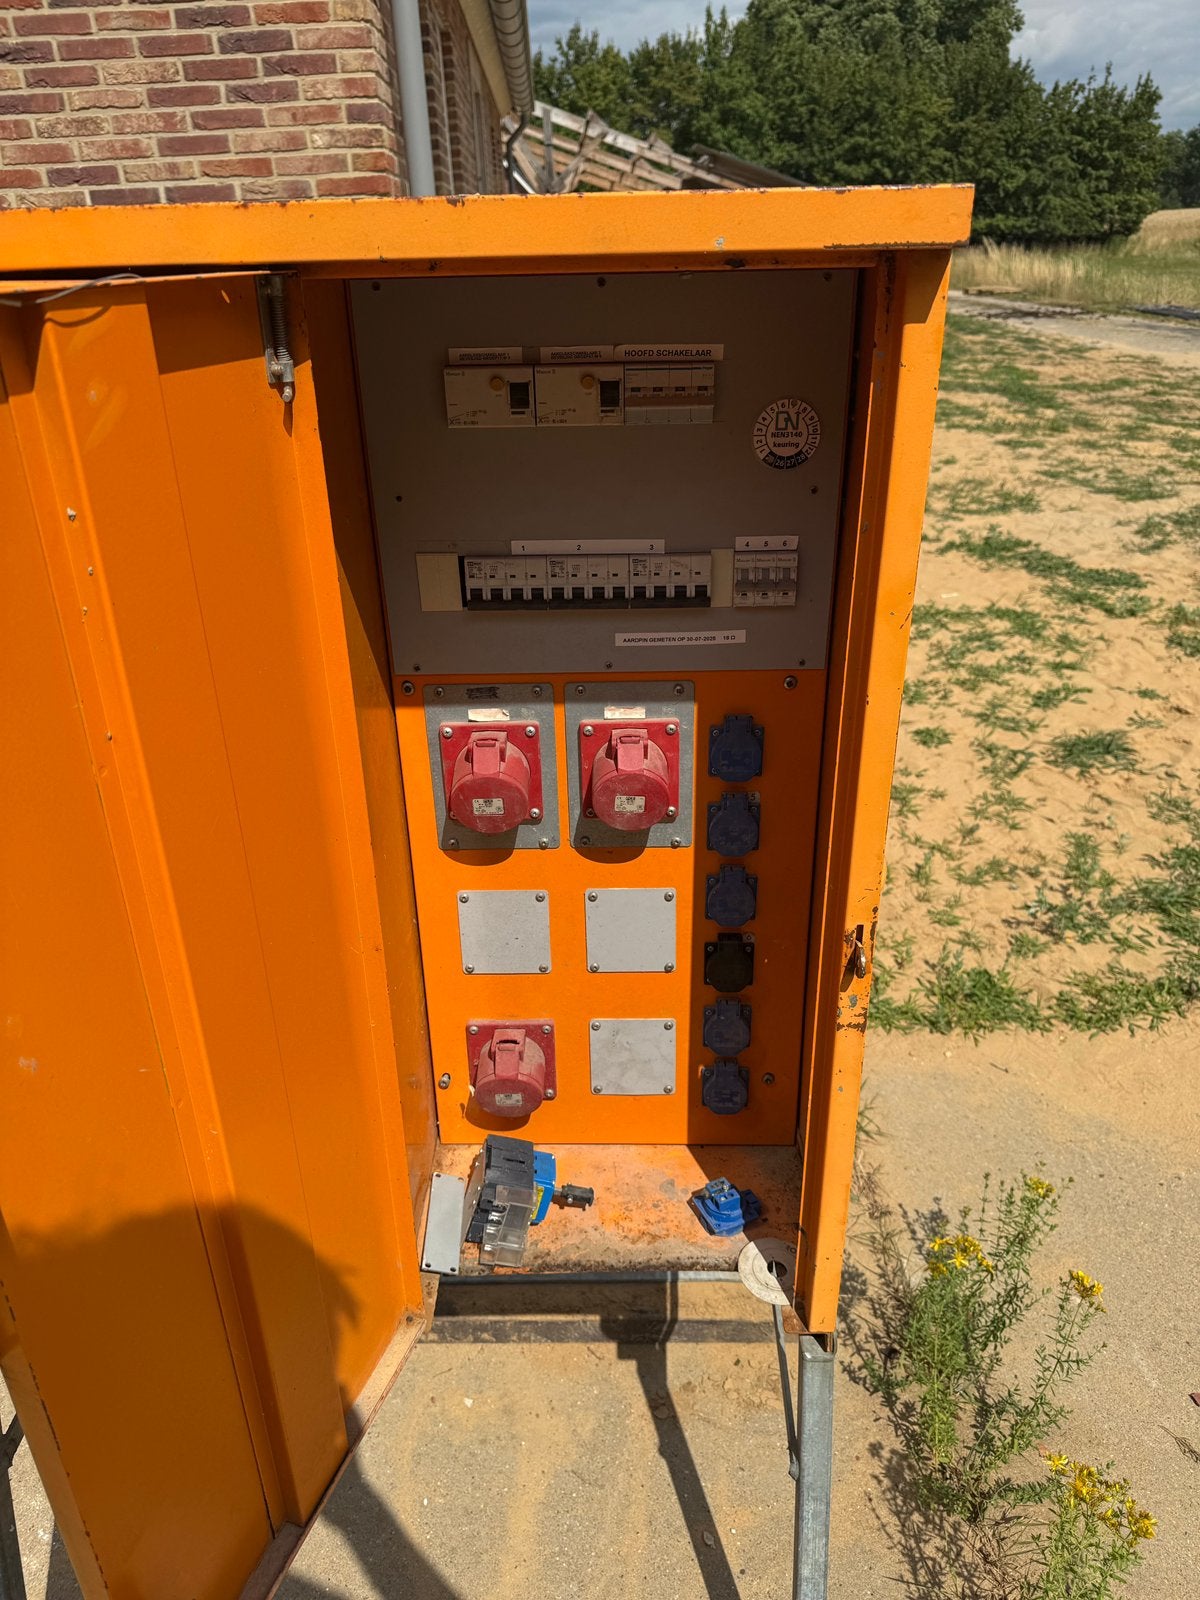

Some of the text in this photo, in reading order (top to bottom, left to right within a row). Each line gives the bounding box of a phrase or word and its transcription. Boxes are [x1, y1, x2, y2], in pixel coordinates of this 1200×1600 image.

[624, 349, 712, 357] HOOFD SCHAKELAAR
[772, 441, 800, 449] keuring
